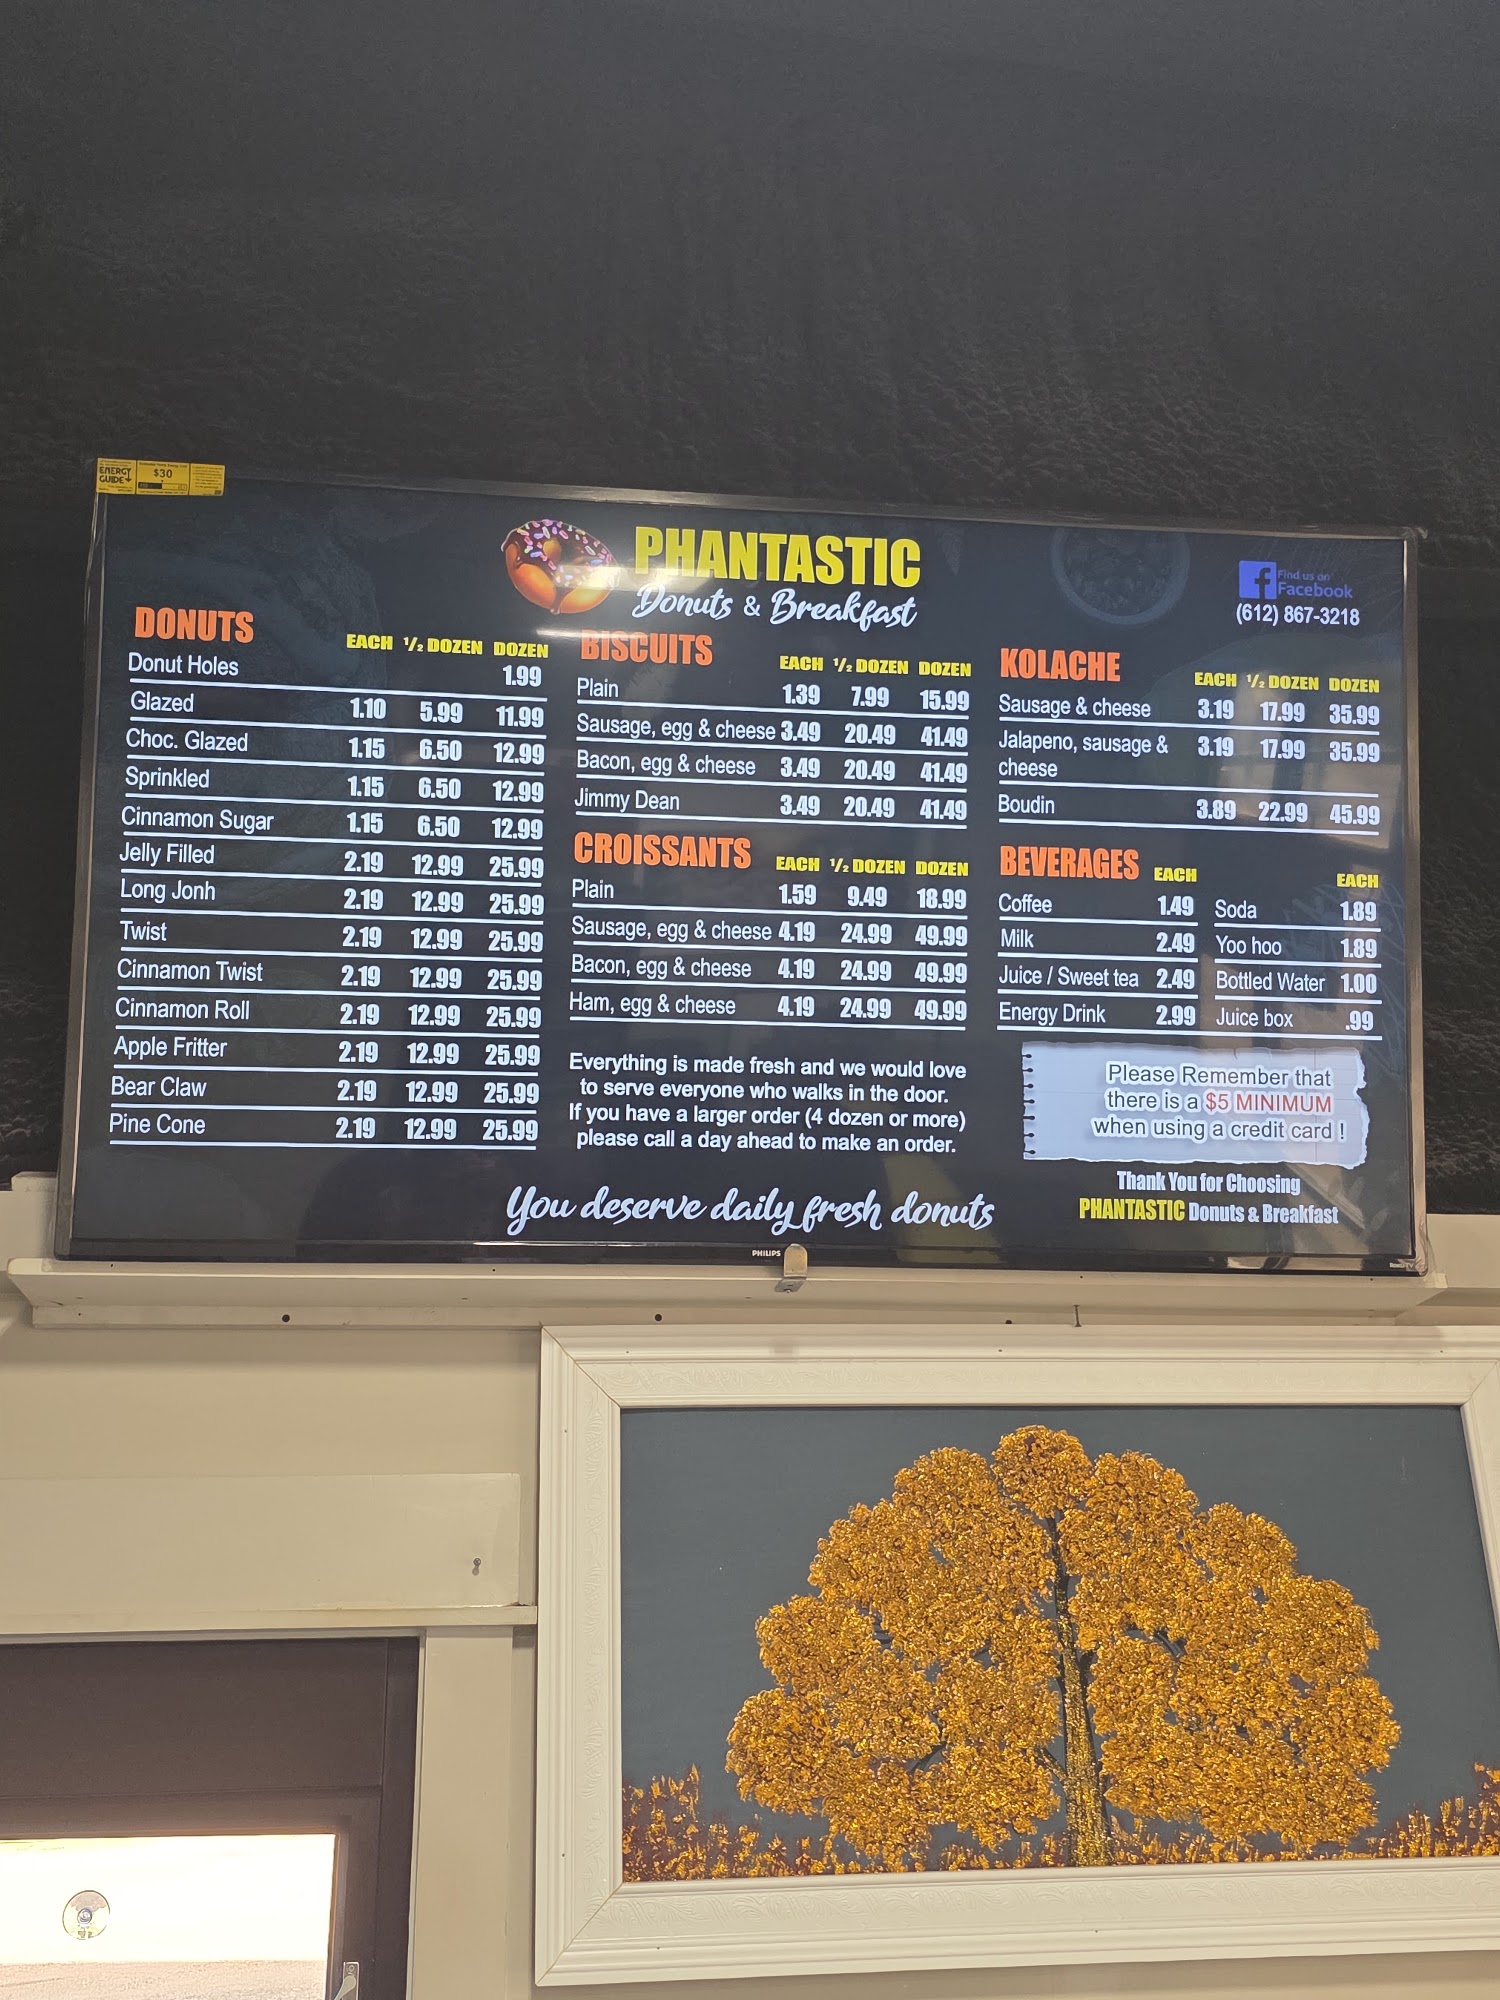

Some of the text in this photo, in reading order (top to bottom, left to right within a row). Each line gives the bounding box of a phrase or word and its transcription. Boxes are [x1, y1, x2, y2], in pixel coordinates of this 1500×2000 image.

[99, 467, 132, 475] ENERGY
[99, 475, 125, 484] GUIDE
[154, 468, 173, 478] $30
[635, 526, 921, 587] PHANTASTIC
[1278, 569, 1330, 582] Find us on
[1277, 582, 1353, 598] Facebook
[631, 583, 917, 632] Donuts & Breakfast
[1237, 603, 1359, 626] (612) 867-3218
[135, 607, 253, 643] DONUTS
[347, 634, 392, 650] EACH
[428, 638, 482, 654] DOZEN
[494, 642, 548, 658] DOZEN
[581, 629, 713, 665] BISCUITS
[129, 652, 541, 687] Donut Holes 1.99
[780, 656, 823, 671] EACH
[856, 659, 908, 674] DOZEN
[919, 662, 971, 676] DOZEN
[1001, 648, 1120, 681] KOLACHE
[578, 678, 969, 711] Plain 1.39 7.99 15.99
[1195, 672, 1236, 687] EACH
[1269, 675, 1318, 690] DOZEN
[1329, 678, 1379, 692] DOZEN
[131, 691, 544, 727] Glazed 1.10 5.99 11.99
[1000, 694, 1379, 725] Sausage & cheese 3.19 17.99 35.99
[577, 713, 967, 747] Sausage, egg & cheese 3.49 20.49 41.49
[126, 728, 544, 764] Choc. Glazed 1.15 6.50 12.99
[999, 730, 1379, 762] Jalapeno, sausage & 3.19 17.99 35.99
[999, 759, 1058, 777] cheese
[575, 788, 967, 820] Jimmy Dean 3.49 20.49 41.49
[575, 832, 751, 868] CROISSANTS
[1001, 846, 1139, 879] BEVERAGES
[776, 856, 819, 871] EACH
[853, 859, 905, 874] DOZEN
[916, 861, 968, 876] DOZEN
[1155, 868, 1196, 882] EACH
[1337, 874, 1378, 888] EACH
[121, 878, 544, 915] Long Jonh 2.19 12.99 25.99
[573, 879, 966, 909] Plain 1.59 9.49 18.99
[999, 894, 1193, 916] Coffee 1.49
[1215, 900, 1376, 921] Soda 1.89
[999, 965, 1194, 989] Juice / Sweet tea 2.49
[1217, 971, 1376, 993] Bottled Water 1.00
[570, 992, 967, 1021] Ham, egg & cheese 4.19 24.99 49.99
[570, 1053, 966, 1078] Everything is made fresh and we would love
[1108, 1064, 1331, 1087] Please Remember that
[1107, 1091, 1332, 1113] there is a $5 MINIMUM
[110, 1113, 538, 1140] Pine Cone 2.19 12.99 25.99
[1094, 1118, 1146, 1136] when
[1154, 1120, 1205, 1141] using
[1212, 1124, 1224, 1137] a
[1231, 1121, 1284, 1138] credit
[1291, 1122, 1332, 1139] card
[577, 1130, 955, 1152] please call a day ahead to make an order.
[507, 1186, 995, 1236] You deserve daily fresh donuts
[1080, 1198, 1338, 1224] PHANTASTIC Donuts & Breakfast
